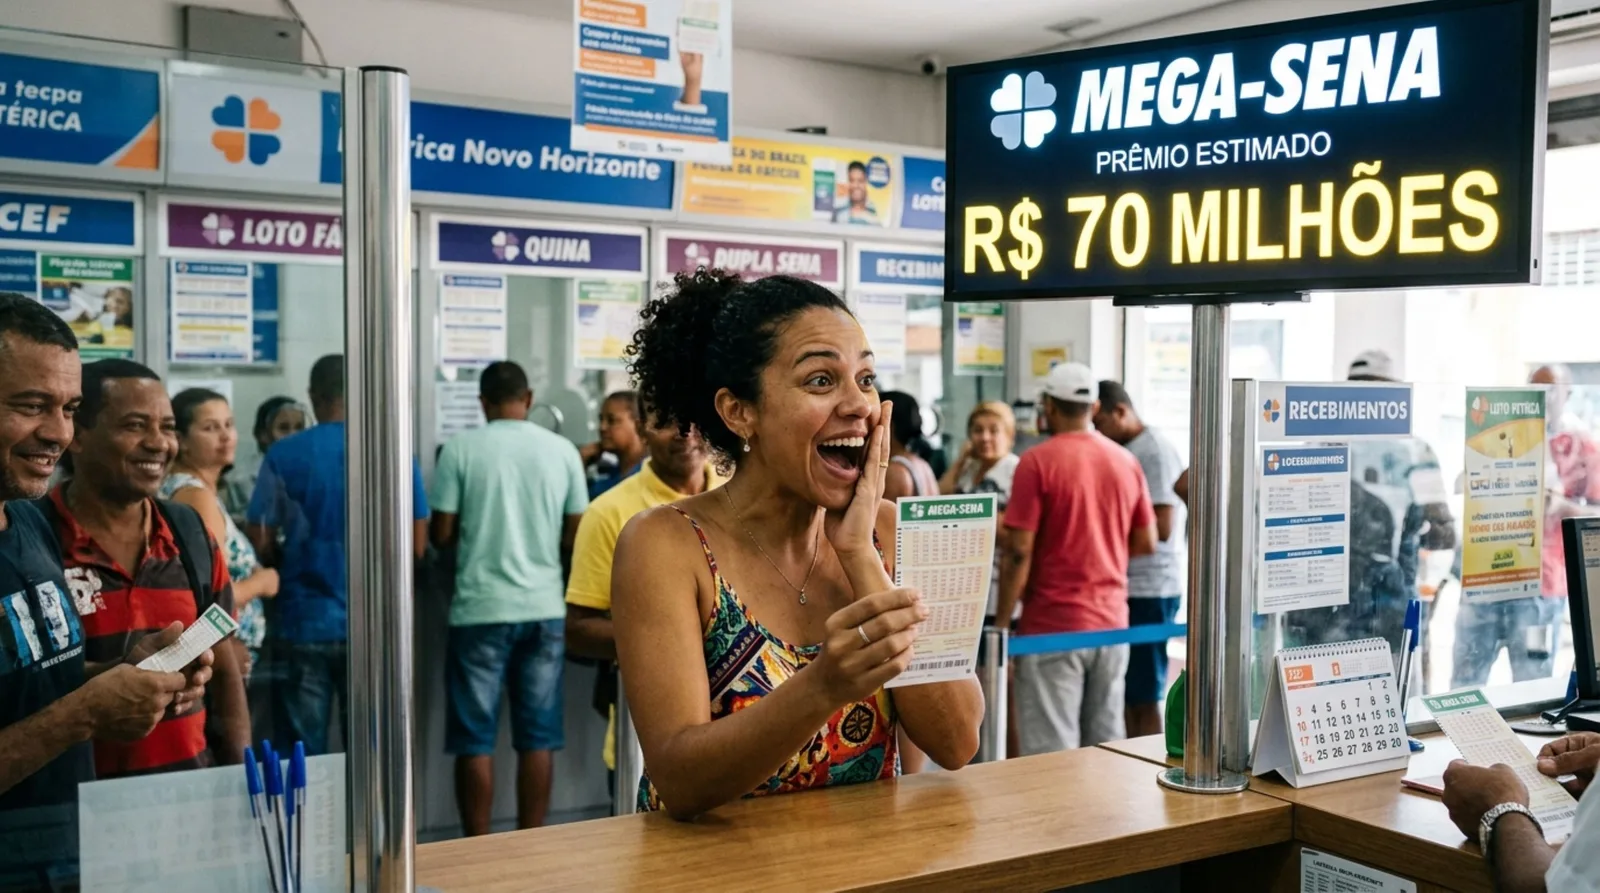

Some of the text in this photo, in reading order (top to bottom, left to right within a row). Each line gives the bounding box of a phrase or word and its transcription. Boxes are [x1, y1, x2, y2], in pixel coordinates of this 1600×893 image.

[1072, 26, 1441, 134] MEGA-SENA
[15, 80, 83, 105] tecpa
[463, 138, 533, 169] Novo
[539, 145, 662, 181] Horizonte
[1096, 131, 1332, 174] PRÊMIO ESTIMADO
[242, 217, 307, 247] LOTO
[963, 161, 1500, 281] R$ 70 MILHÕES
[524, 236, 591, 263] QUINA
[776, 252, 821, 276] SENA
[1289, 400, 1408, 420] RECEBIMENTOS
[1383, 680, 1387, 689] 2
[1311, 705, 1317, 714] 4
[1326, 702, 1332, 712] 5
[1341, 700, 1346, 710] 6
[1355, 698, 1360, 707] 7
[1371, 696, 1376, 706] 8
[1384, 694, 1390, 704] 9
[1297, 708, 1396, 732] 10 11 12 13 14 15 16
[1300, 736, 1309, 746] 17
[1315, 734, 1325, 745] 18
[1330, 732, 1340, 742] 19
[1345, 730, 1355, 740] 20
[1359, 727, 1369, 738] 21
[1374, 725, 1384, 735] 22
[1317, 750, 1328, 761] 25
[1332, 747, 1343, 758] 26
[1347, 745, 1357, 755] 27
[1377, 740, 1387, 750] 29
